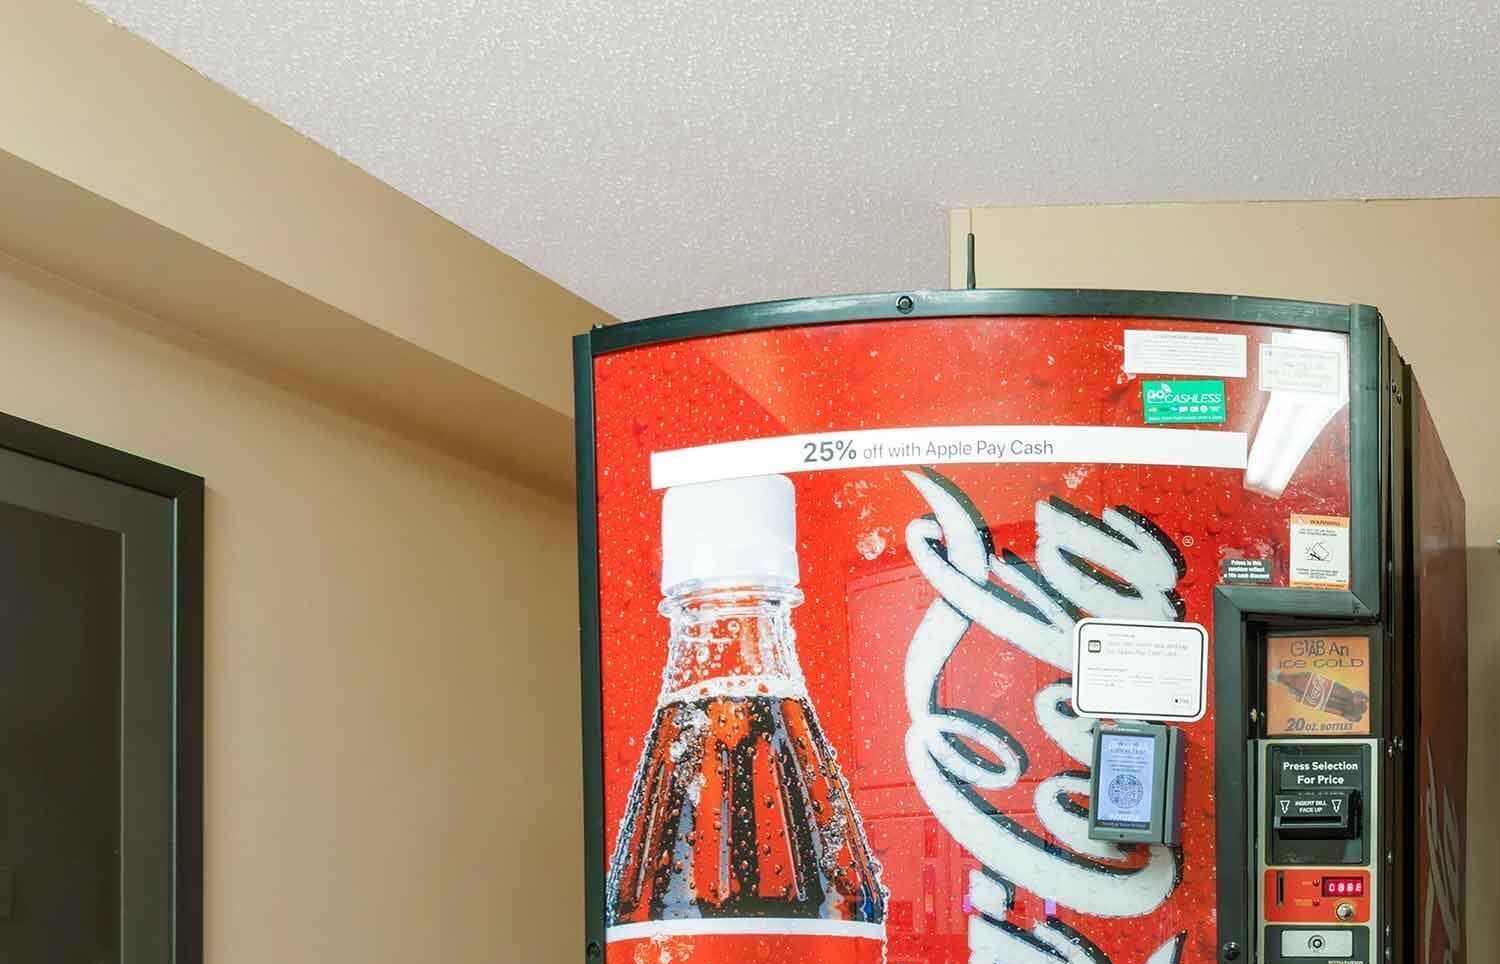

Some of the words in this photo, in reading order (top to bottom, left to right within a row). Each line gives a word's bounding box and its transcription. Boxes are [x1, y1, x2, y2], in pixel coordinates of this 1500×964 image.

[1164, 391, 1222, 404] CASHLESS
[803, 440, 857, 463] 25%
[863, 446, 883, 460] off
[887, 443, 921, 458] with
[925, 441, 972, 461] Apple
[976, 439, 1005, 457] Pay
[1010, 438, 1054, 456] Cash
[1312, 659, 1364, 668] COLD
[1286, 717, 1306, 732] 20
[1283, 761, 1310, 771] Press
[1311, 761, 1359, 771] Selection
[1297, 775, 1315, 785] For
[1317, 775, 1345, 785] Price
